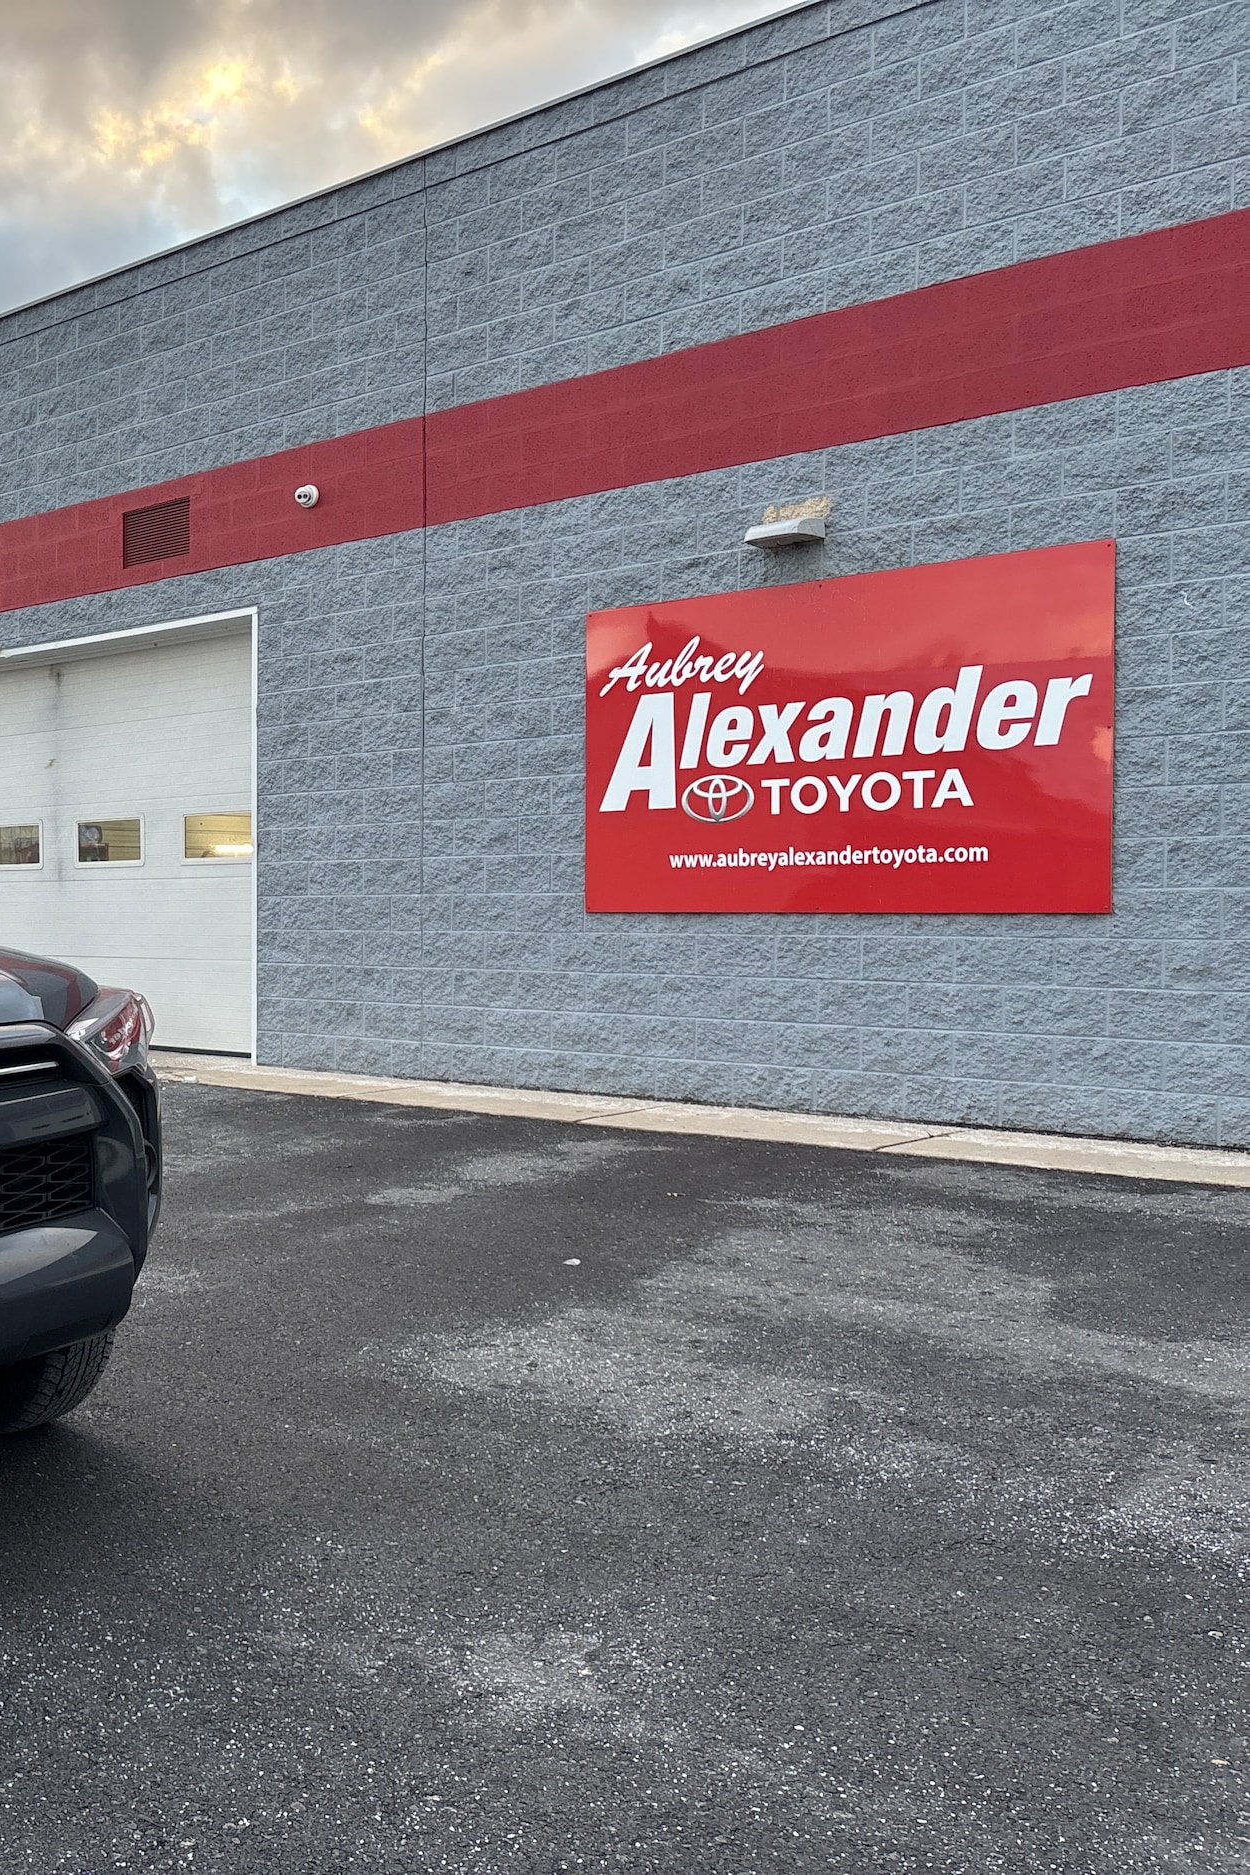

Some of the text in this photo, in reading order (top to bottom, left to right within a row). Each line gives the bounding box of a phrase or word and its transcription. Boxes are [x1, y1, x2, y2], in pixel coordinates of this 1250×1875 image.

[599, 635, 765, 697] Aubrey
[598, 664, 1094, 812] Alexander
[760, 768, 974, 815] TOYOTA
[669, 844, 989, 872] www.aubreyalexandertoyota.com
